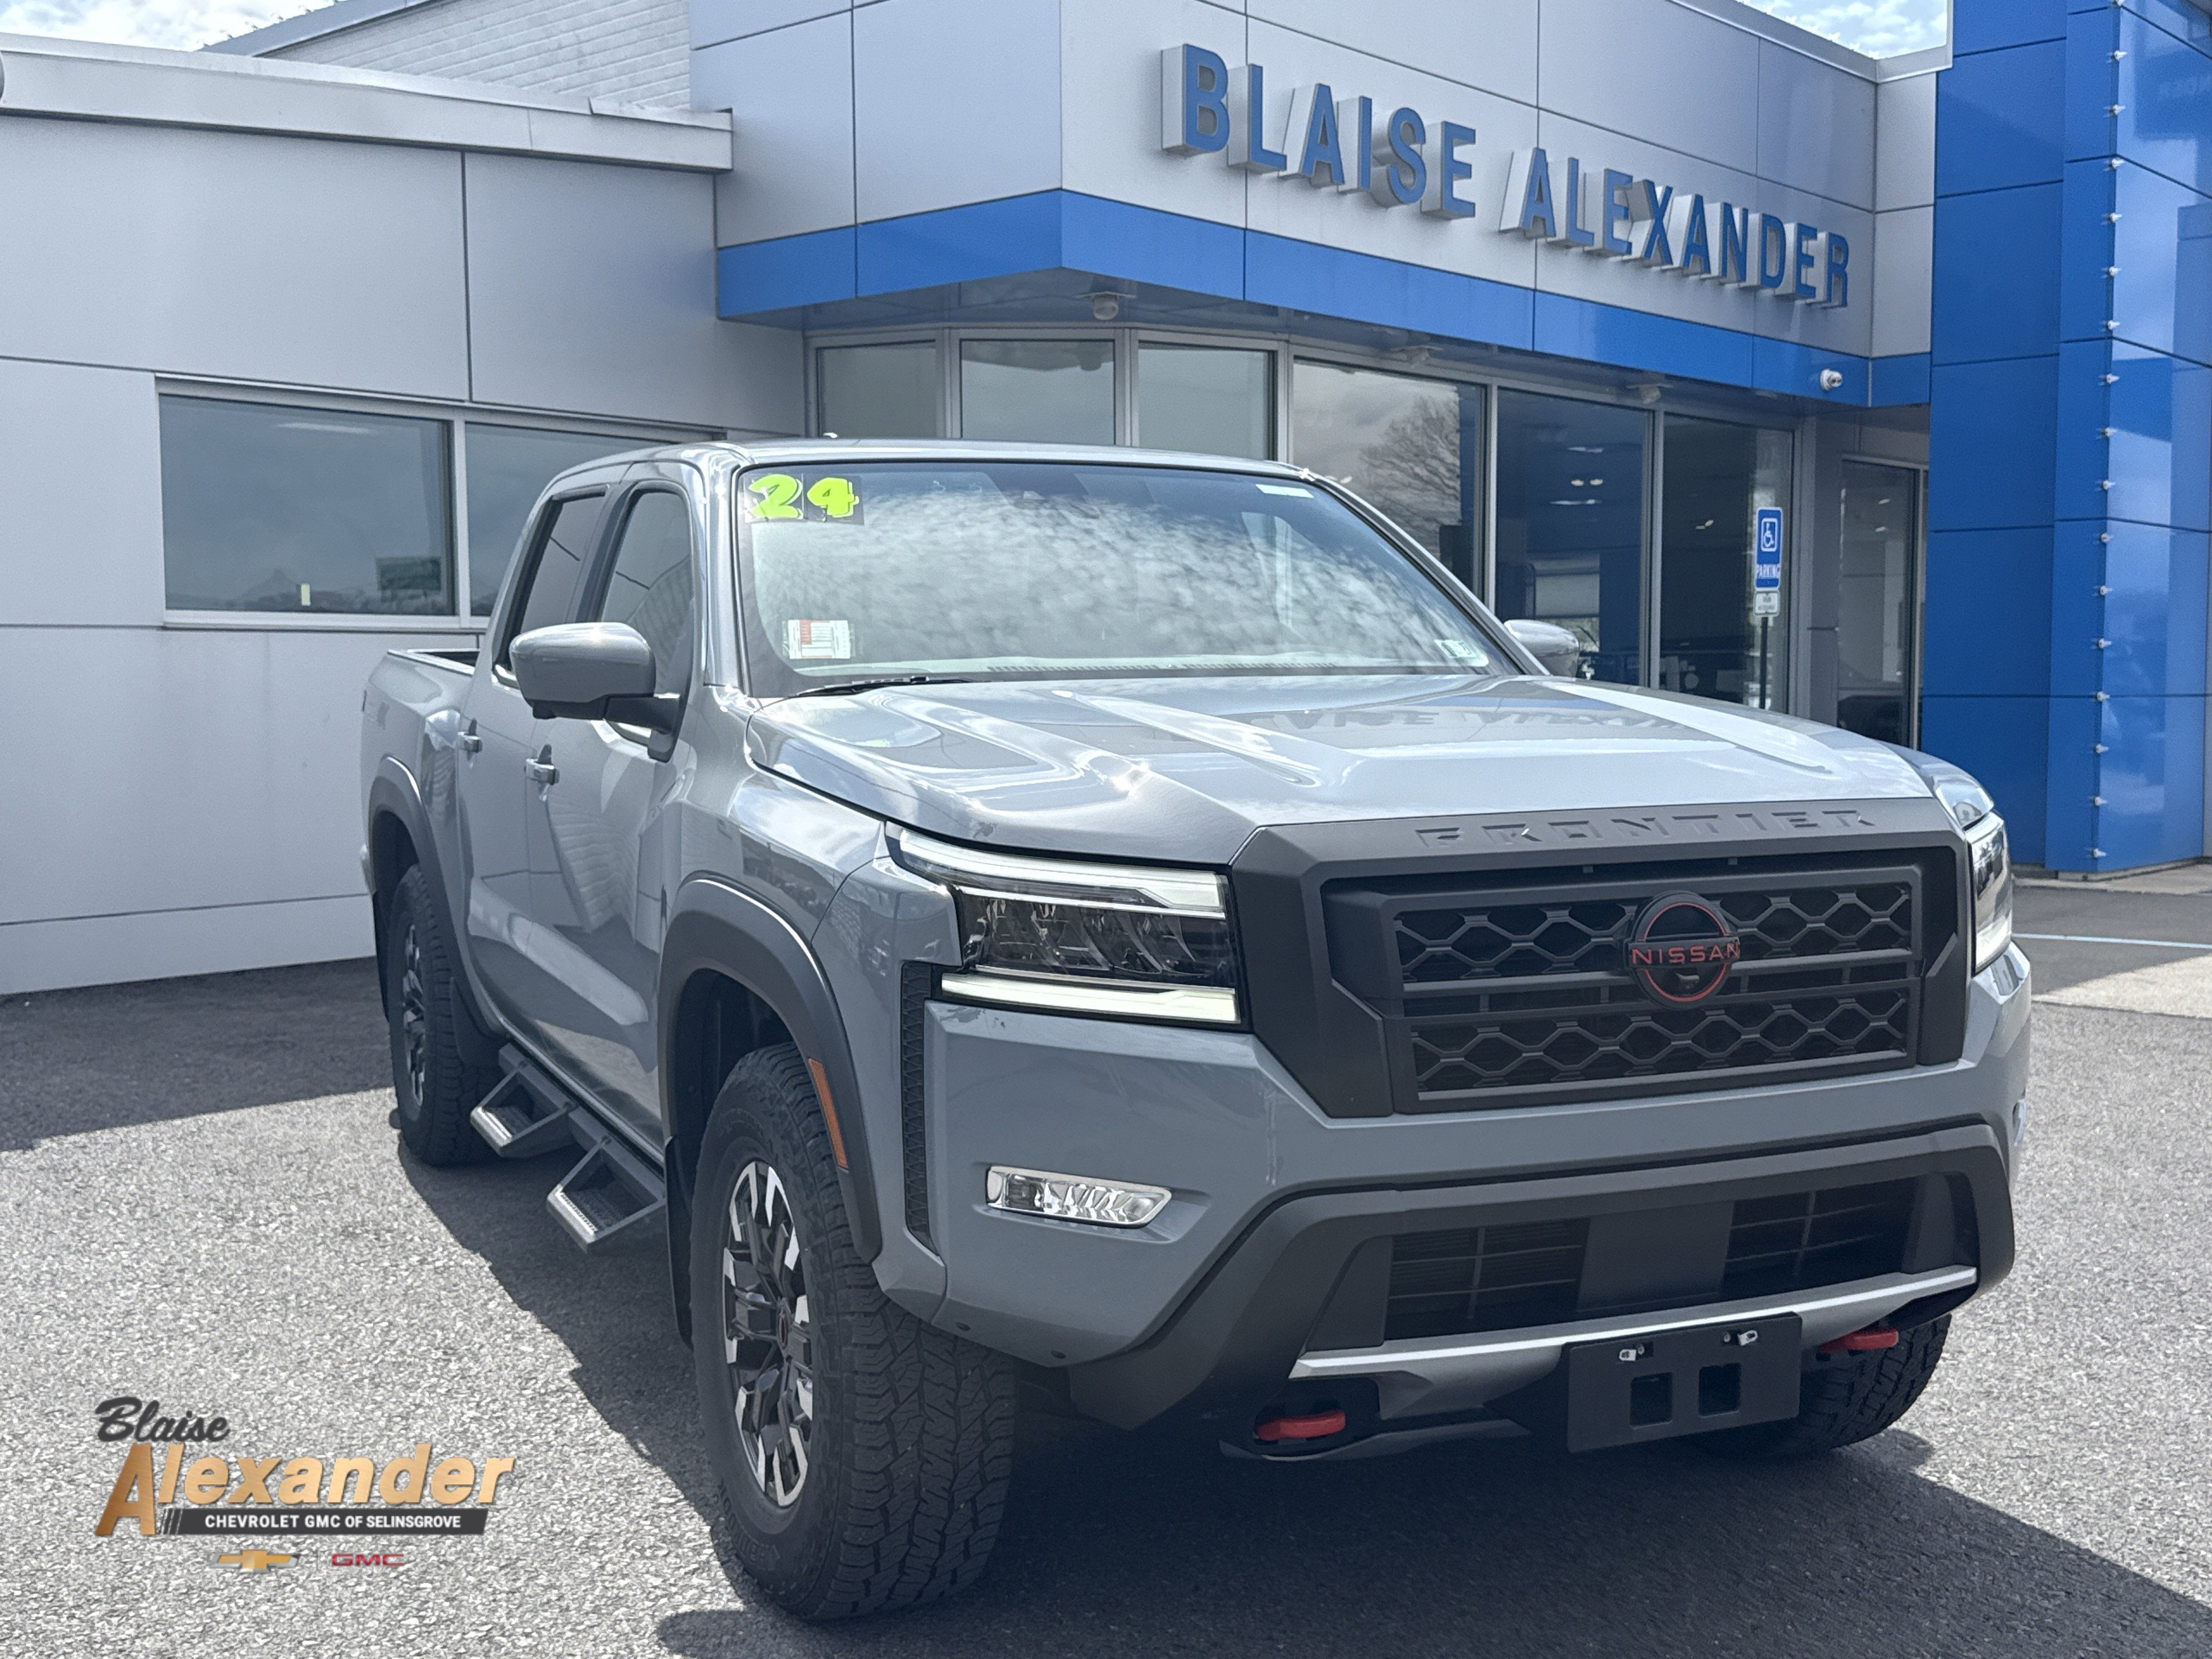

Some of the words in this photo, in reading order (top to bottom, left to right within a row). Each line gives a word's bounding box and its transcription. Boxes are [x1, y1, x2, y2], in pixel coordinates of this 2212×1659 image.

[1161, 43, 1476, 219] BLAISE
[1499, 146, 1849, 308] ALEXANDER
[1414, 810, 1875, 848] FRONTIER
[1631, 941, 1740, 965] NISSAN
